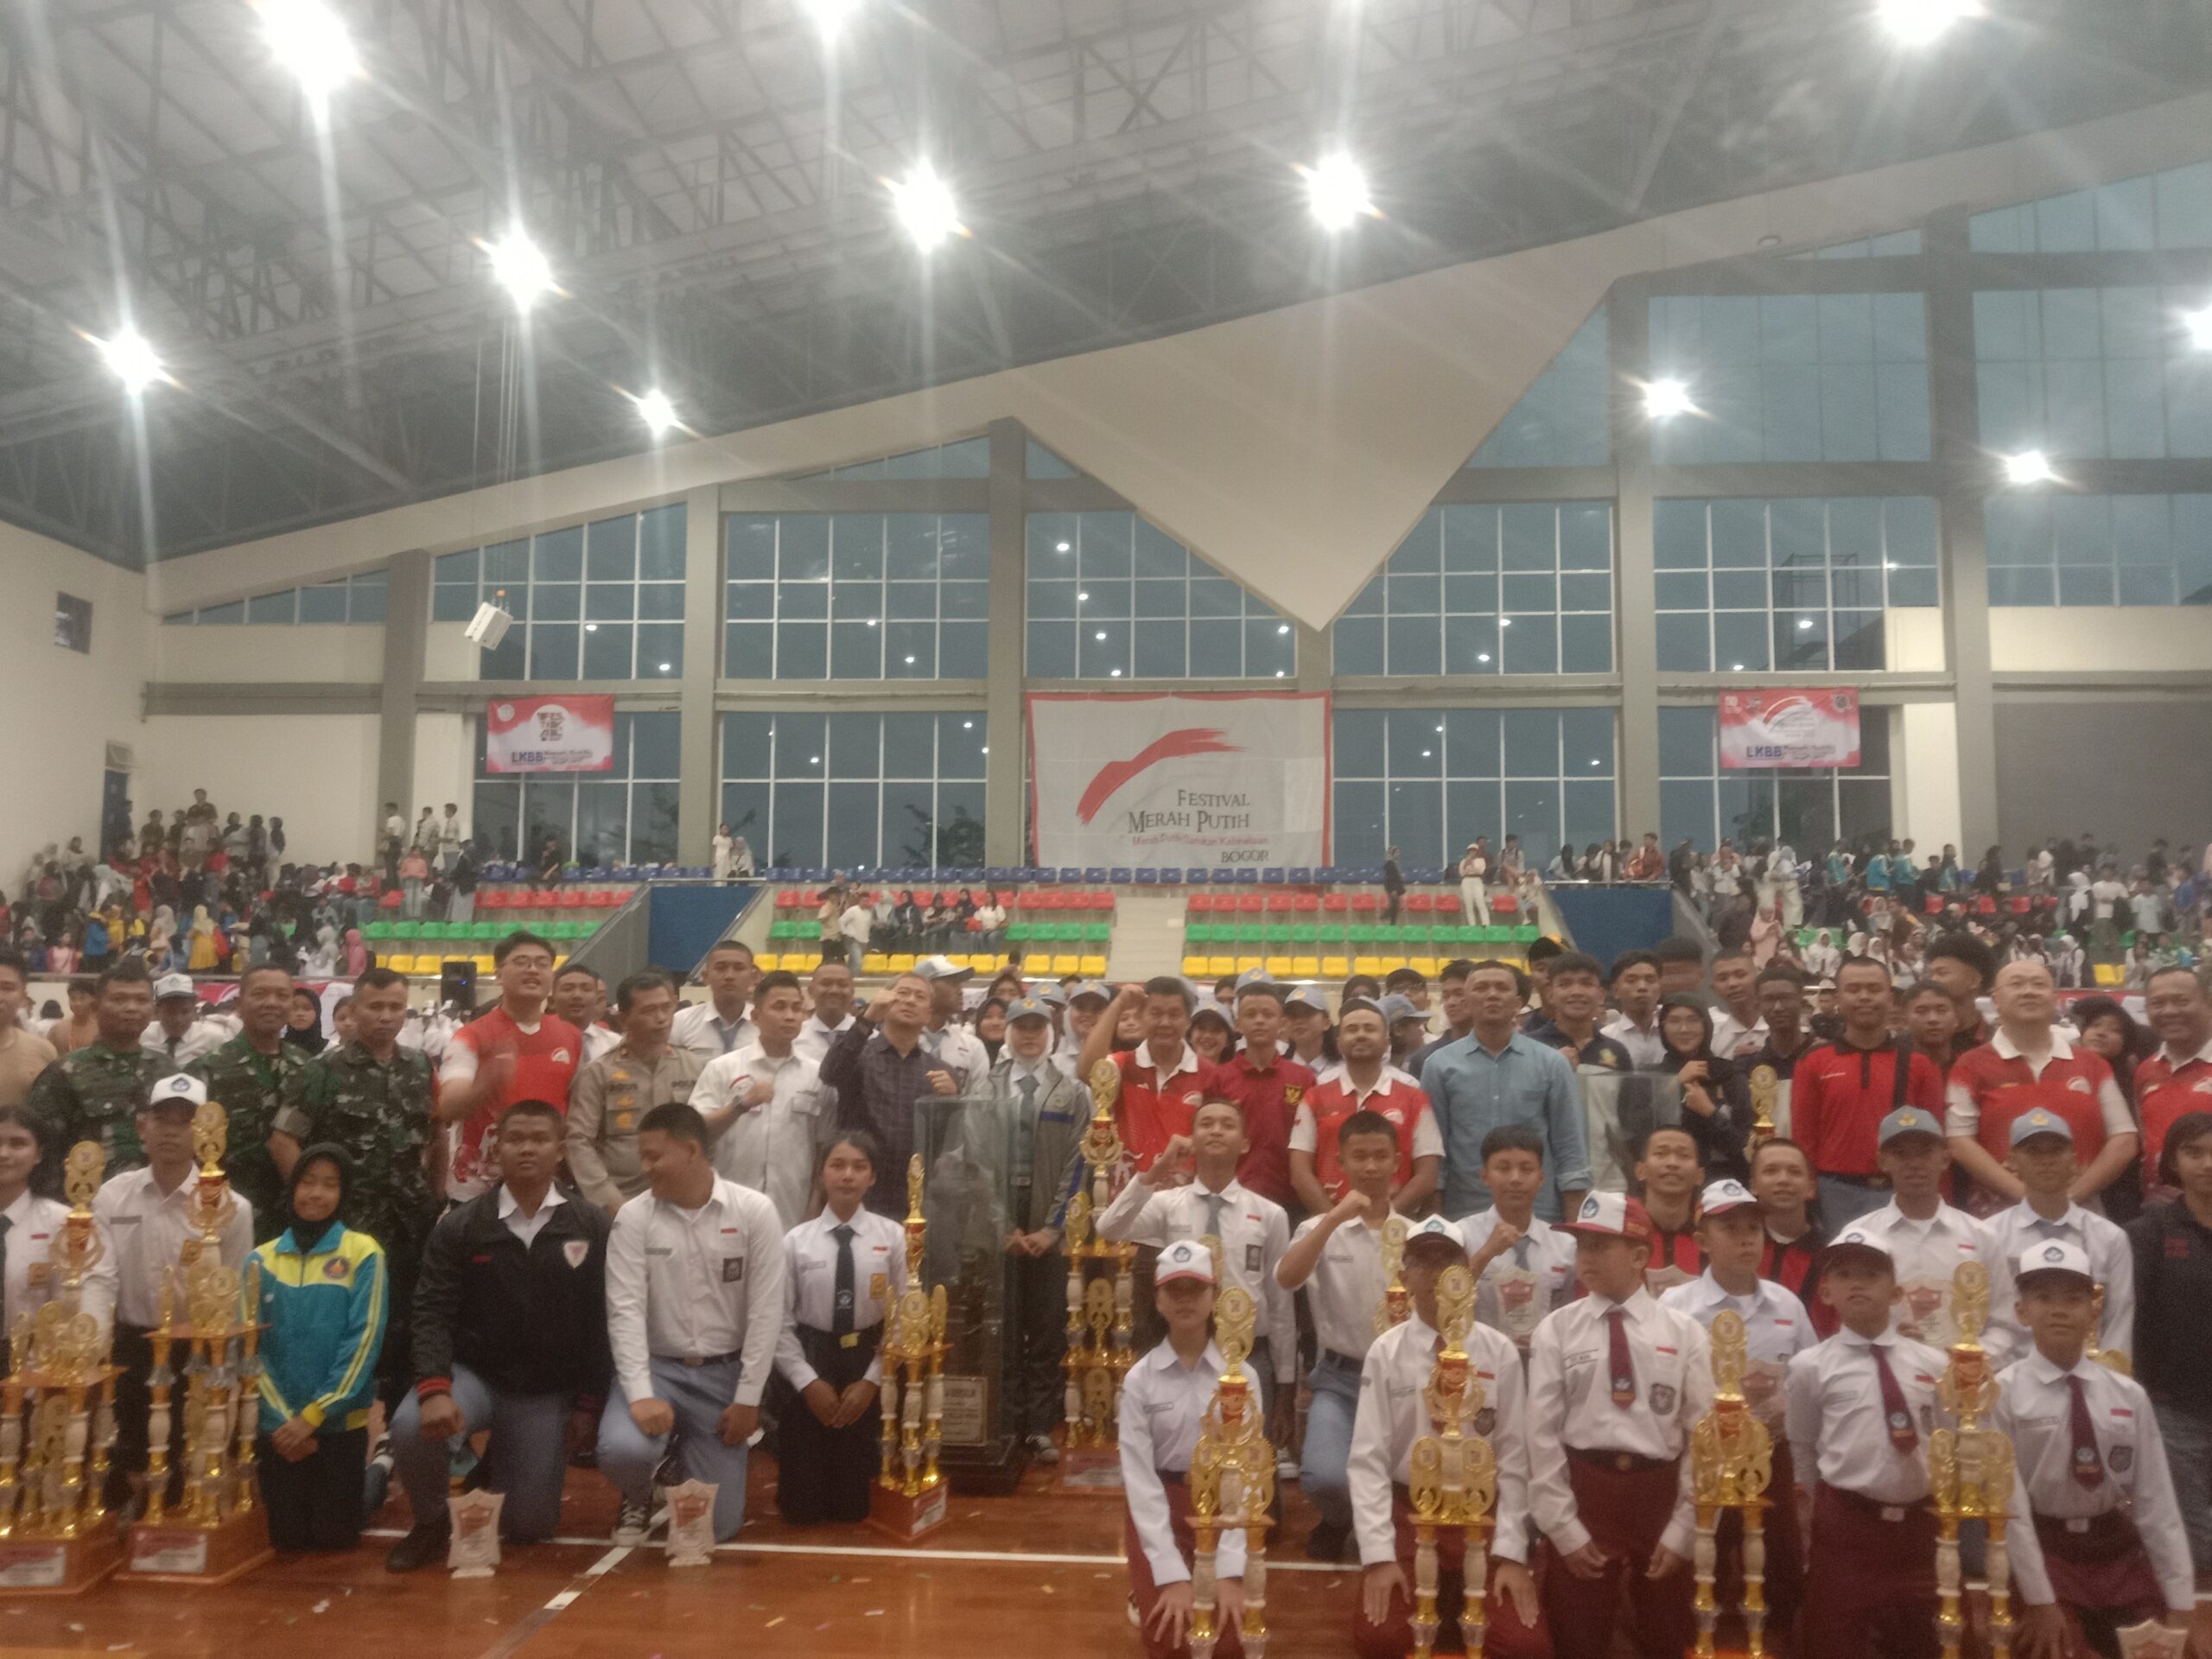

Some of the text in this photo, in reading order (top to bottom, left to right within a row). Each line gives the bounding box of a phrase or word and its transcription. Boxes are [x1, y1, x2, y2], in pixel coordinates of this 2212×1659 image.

[512, 751, 543, 763] LKBB
[1745, 746, 1782, 758] LKBB
[1177, 790, 1250, 807] FESTIVAL
[1128, 810, 1250, 833] MERAH PUTIH
[1220, 849, 1270, 863] BOGOR
